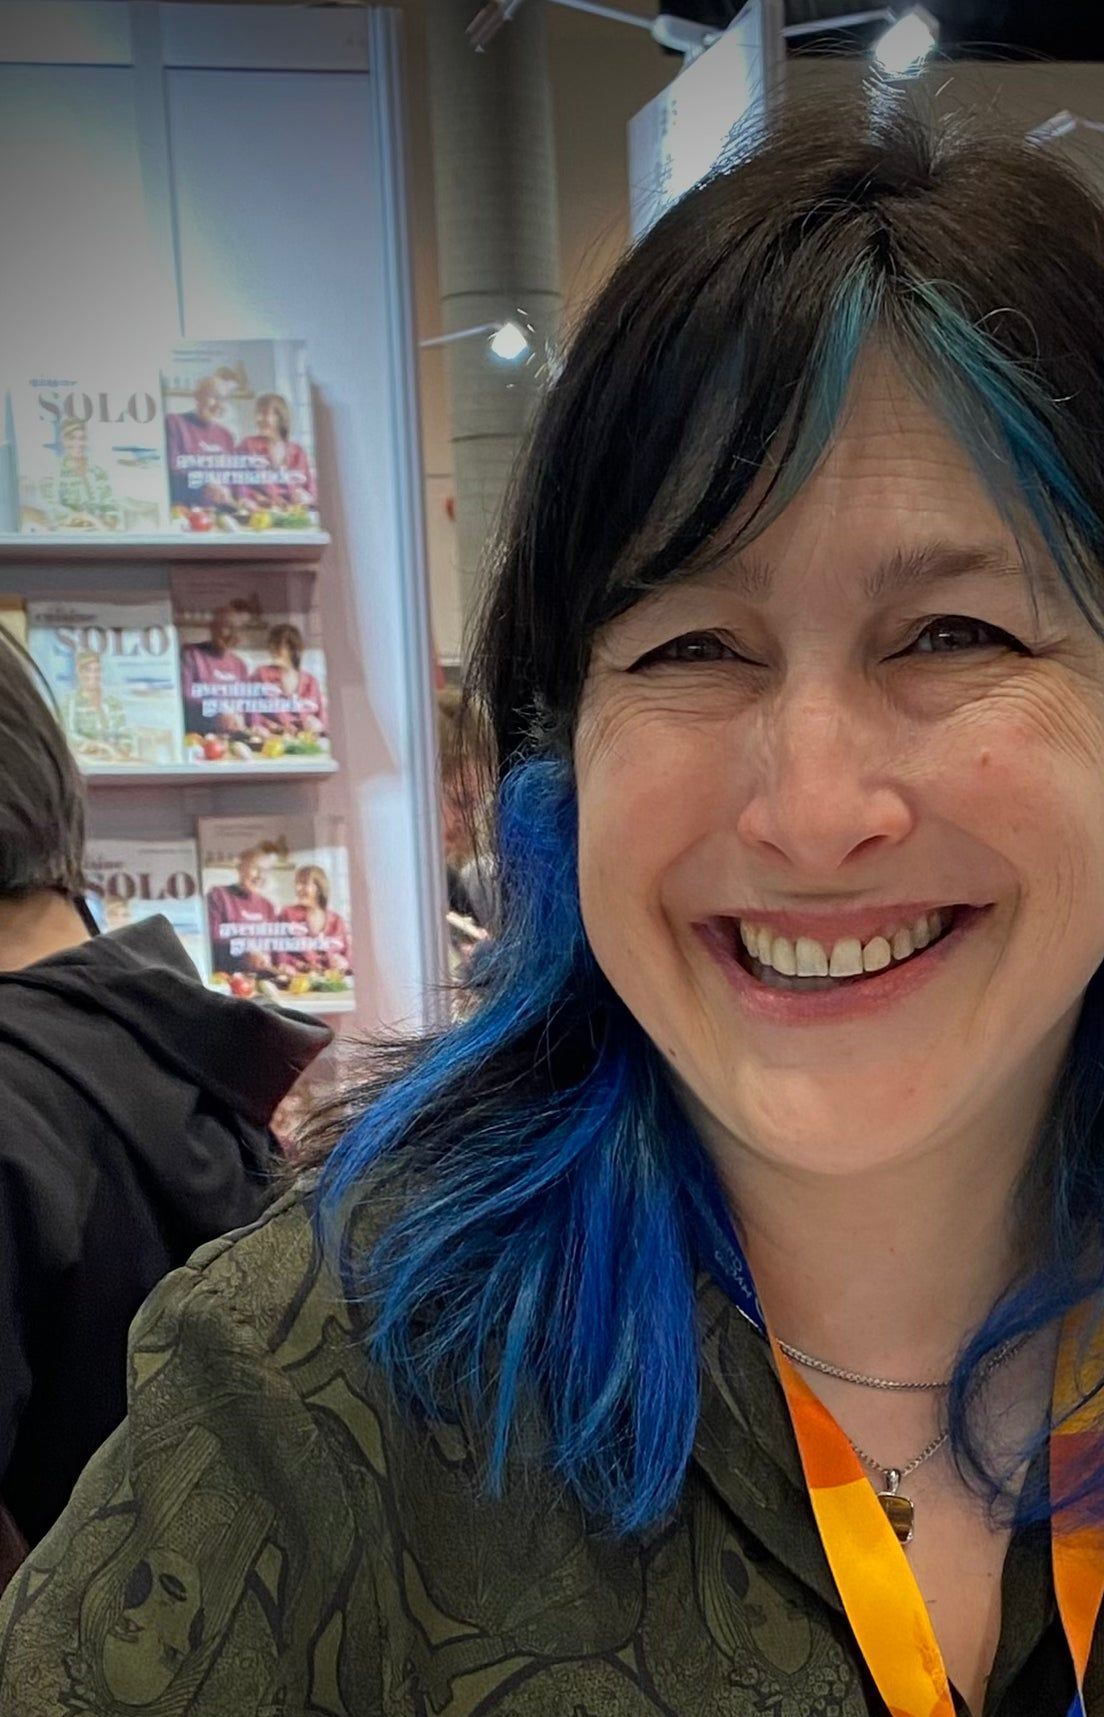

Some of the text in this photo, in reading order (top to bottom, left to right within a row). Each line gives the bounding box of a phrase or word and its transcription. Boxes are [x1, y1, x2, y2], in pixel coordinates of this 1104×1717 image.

[38, 392, 157, 424] SOLO
[54, 625, 170, 658] SOLO
[84, 870, 196, 901] SOLO
